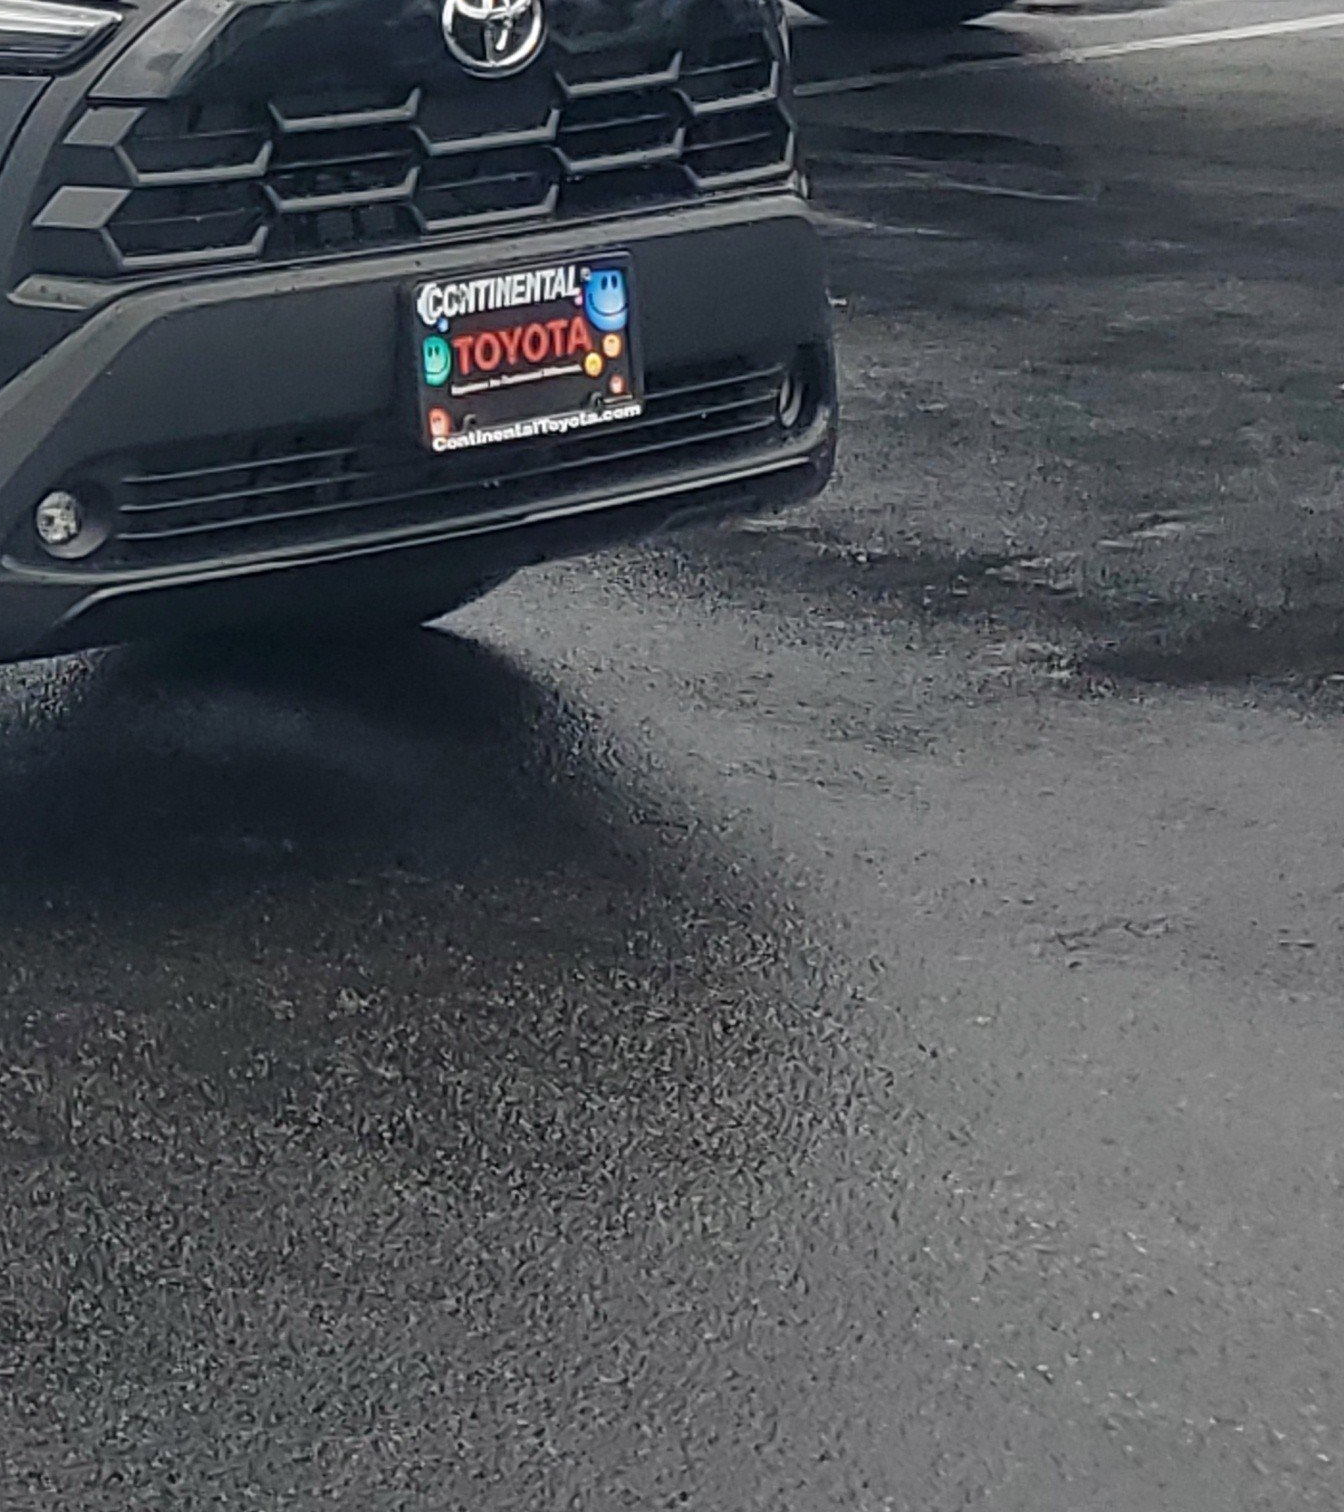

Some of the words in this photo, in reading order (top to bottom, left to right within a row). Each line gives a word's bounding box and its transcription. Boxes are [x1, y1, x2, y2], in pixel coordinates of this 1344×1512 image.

[416, 265, 581, 325] CONTINENTAL
[453, 317, 593, 374] TOYOTA
[432, 404, 642, 452] ContinentalToyota.com
